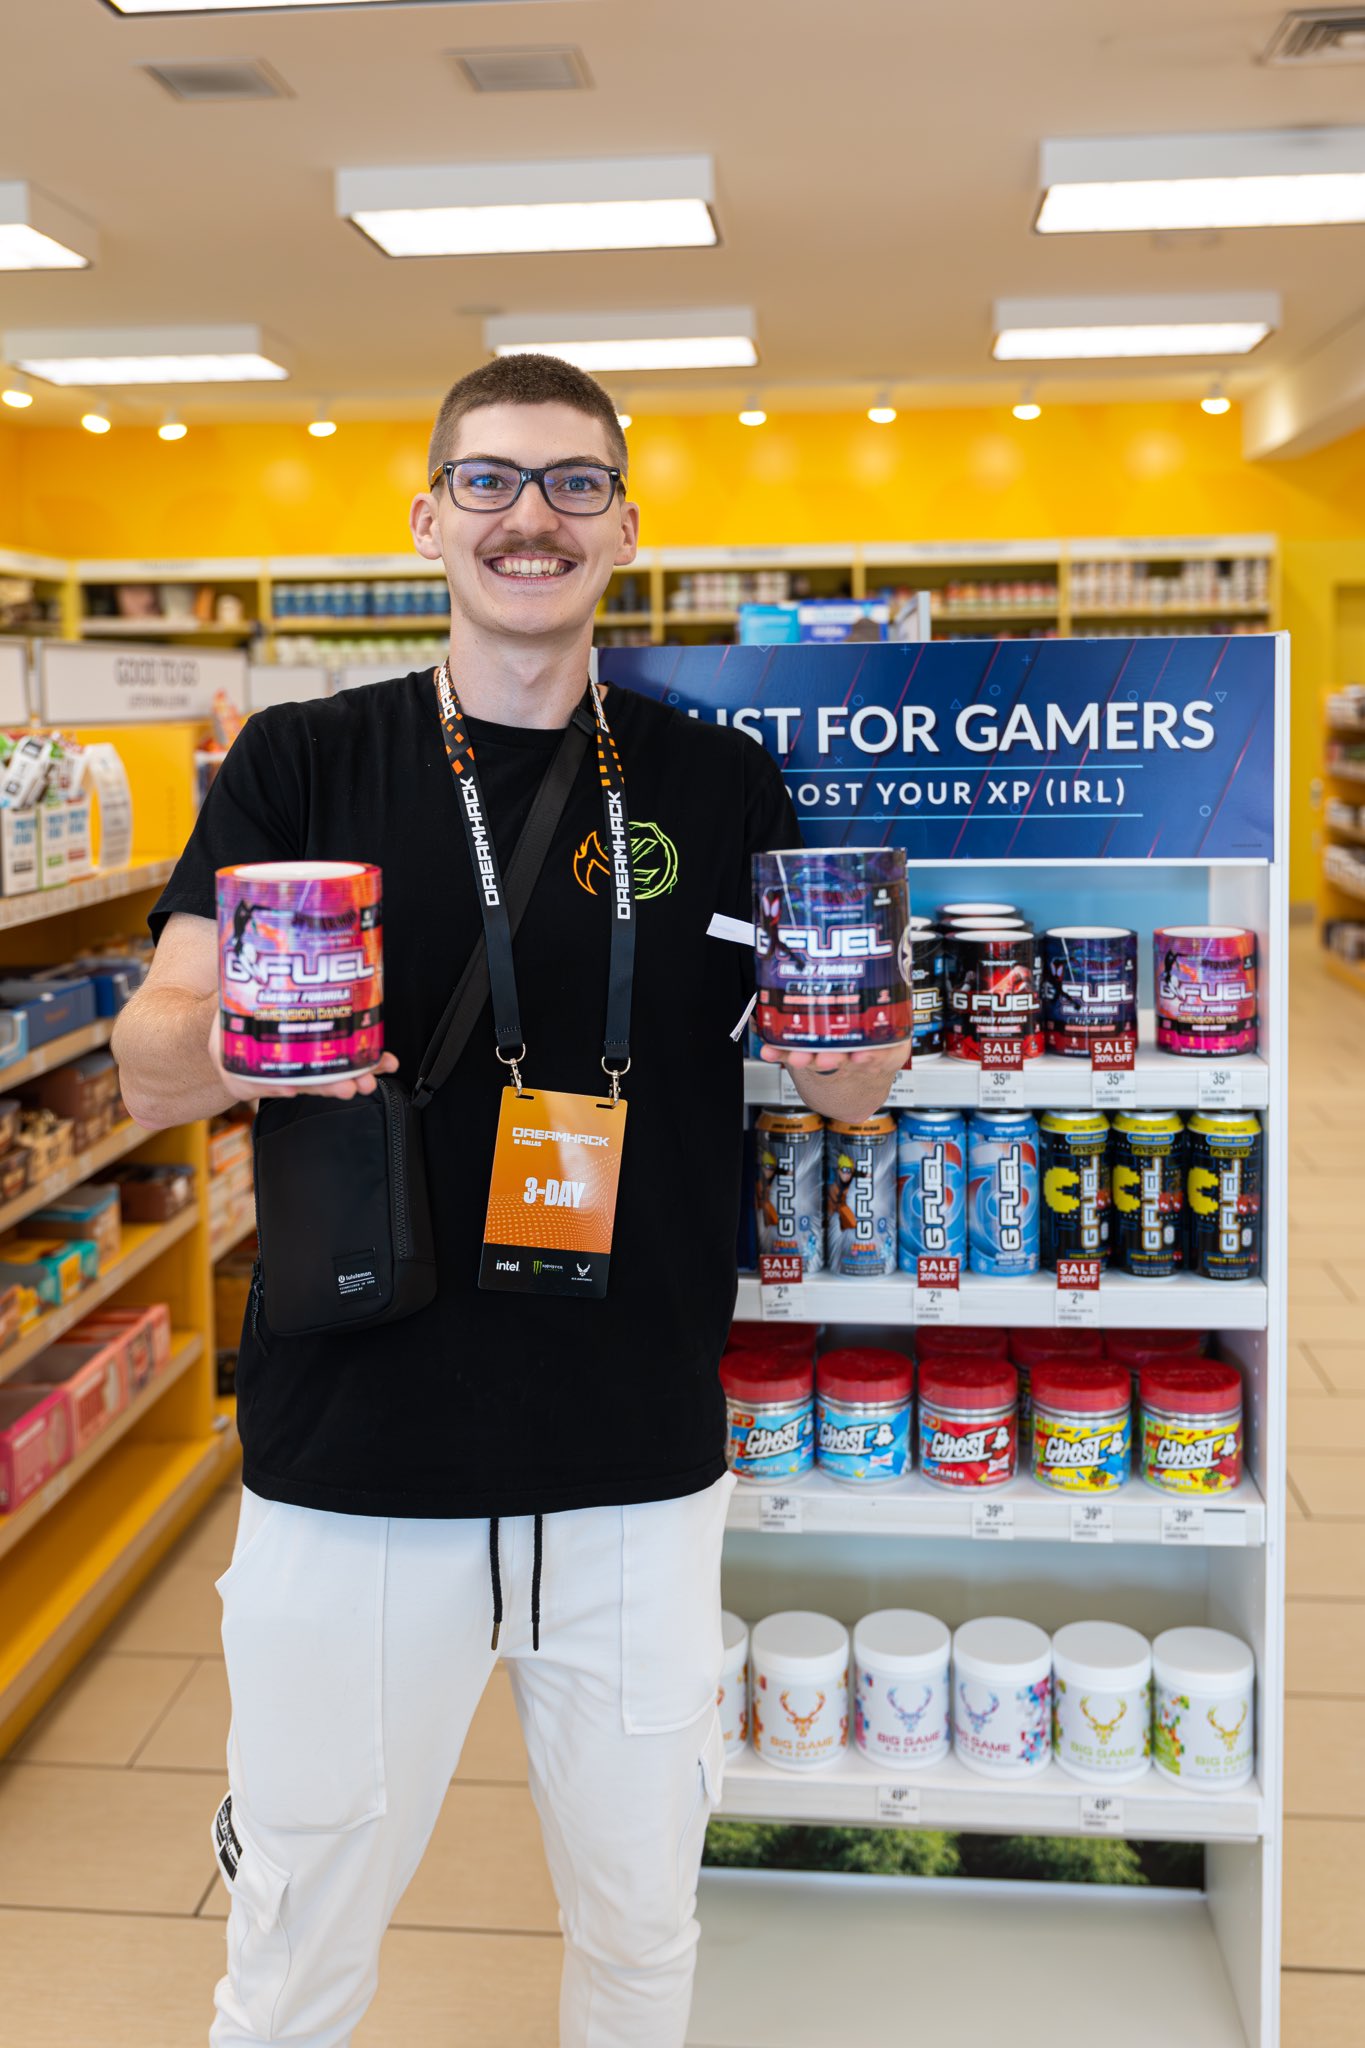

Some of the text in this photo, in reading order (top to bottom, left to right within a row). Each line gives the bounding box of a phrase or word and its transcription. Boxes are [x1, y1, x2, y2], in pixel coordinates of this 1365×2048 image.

[688, 700, 1215, 754] ST FOR GAMERS
[784, 777, 1125, 806] OST YOUR XP (IRL)
[459, 775, 500, 906] DREAMHACK
[607, 790, 631, 920] DREAMHACK
[777, 927, 893, 958] FUEL
[260, 950, 375, 984] FUEL
[952, 992, 1040, 1012] G FUEL
[1062, 984, 1134, 1003] FUEL
[1179, 982, 1253, 1002] FUEL
[983, 1042, 1022, 1055] SALE
[984, 1054, 1021, 1064] 20% OFF
[1094, 1041, 1133, 1054] SALE
[1094, 1052, 1132, 1063] 20% OFF
[511, 1127, 611, 1147] DREAMHACK
[523, 1177, 586, 1209] 3-DAY
[778, 1146, 794, 1216] FUEL
[857, 1147, 873, 1217] FUEL
[923, 1144, 944, 1225] FUEL
[1000, 1144, 1020, 1226] FUEL
[1082, 1156, 1098, 1226] FUEL
[1143, 1157, 1161, 1228] FUEL
[1221, 1159, 1240, 1230] FUEL
[763, 1258, 800, 1270] SALE
[764, 1270, 800, 1279] 20% OFF
[919, 1260, 957, 1272] SALE
[919, 1272, 957, 1281] 20% OFF
[1059, 1263, 1098, 1274] SALE
[1059, 1274, 1098, 1284] 20% OFF
[744, 1414, 807, 1459] GHOST
[819, 1423, 878, 1456] GHOST
[930, 1427, 997, 1462] GHOST
[1043, 1432, 1113, 1467] GHOST
[1154, 1434, 1226, 1470] GHOST
[877, 1730, 941, 1746] BIG GAME
